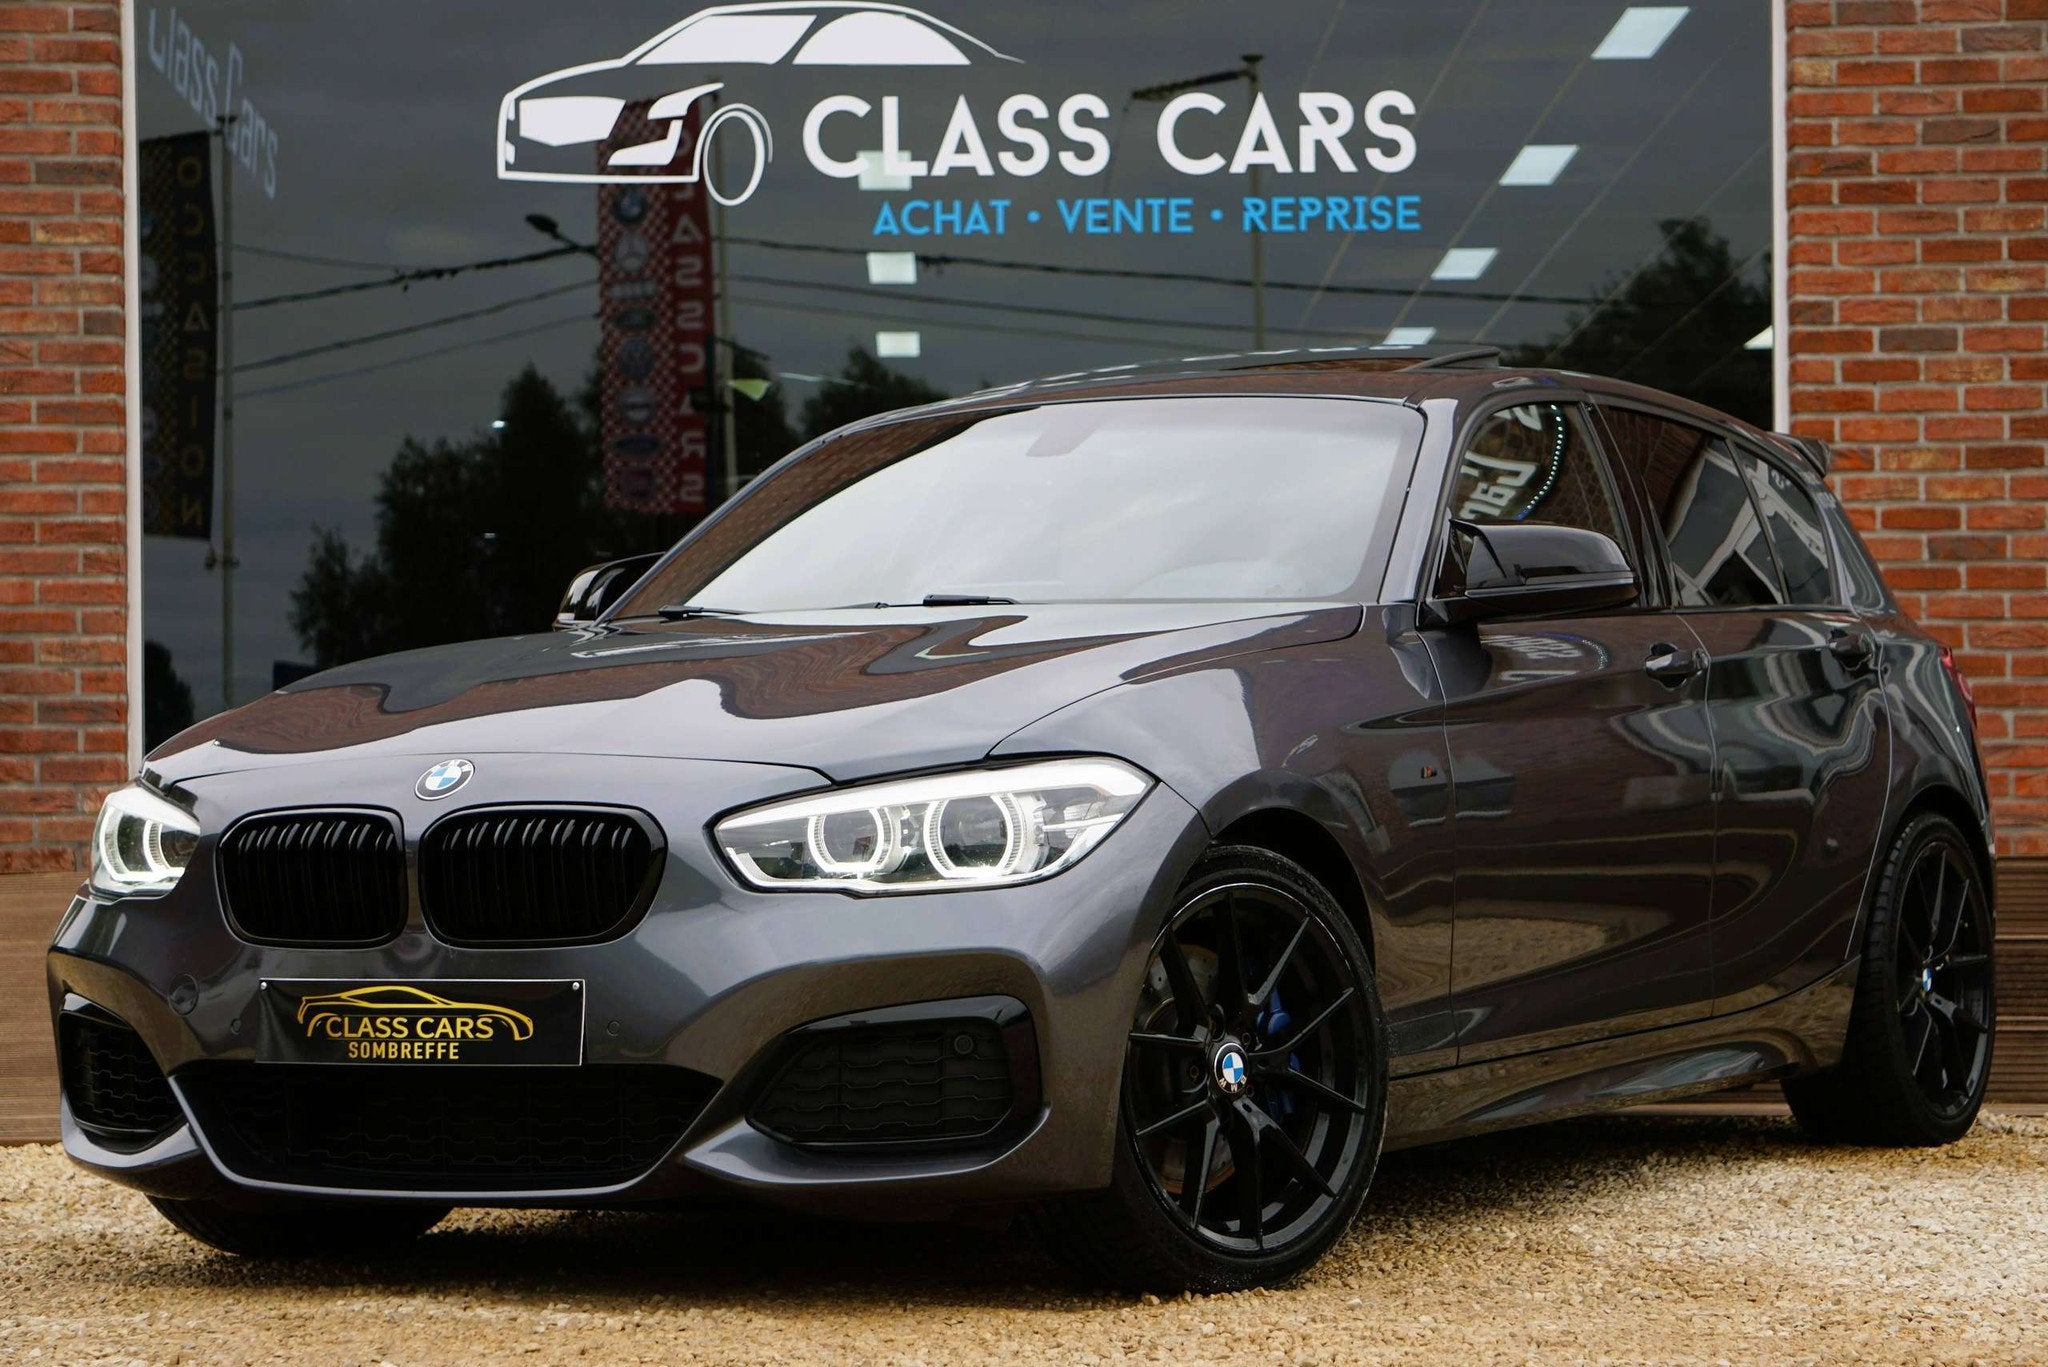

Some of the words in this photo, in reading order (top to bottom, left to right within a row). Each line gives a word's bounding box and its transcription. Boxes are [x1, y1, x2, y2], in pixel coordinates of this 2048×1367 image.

[803, 93, 1110, 178] CLASS
[1157, 90, 1417, 176] CARS
[872, 199, 1012, 236] ACHAT
[1056, 197, 1195, 234] VENTE
[1241, 195, 1422, 233] REPRISE
[324, 1016, 410, 1040] CLASS
[415, 1015, 494, 1040] CARS
[347, 1041, 460, 1060] SOMBREFFE
